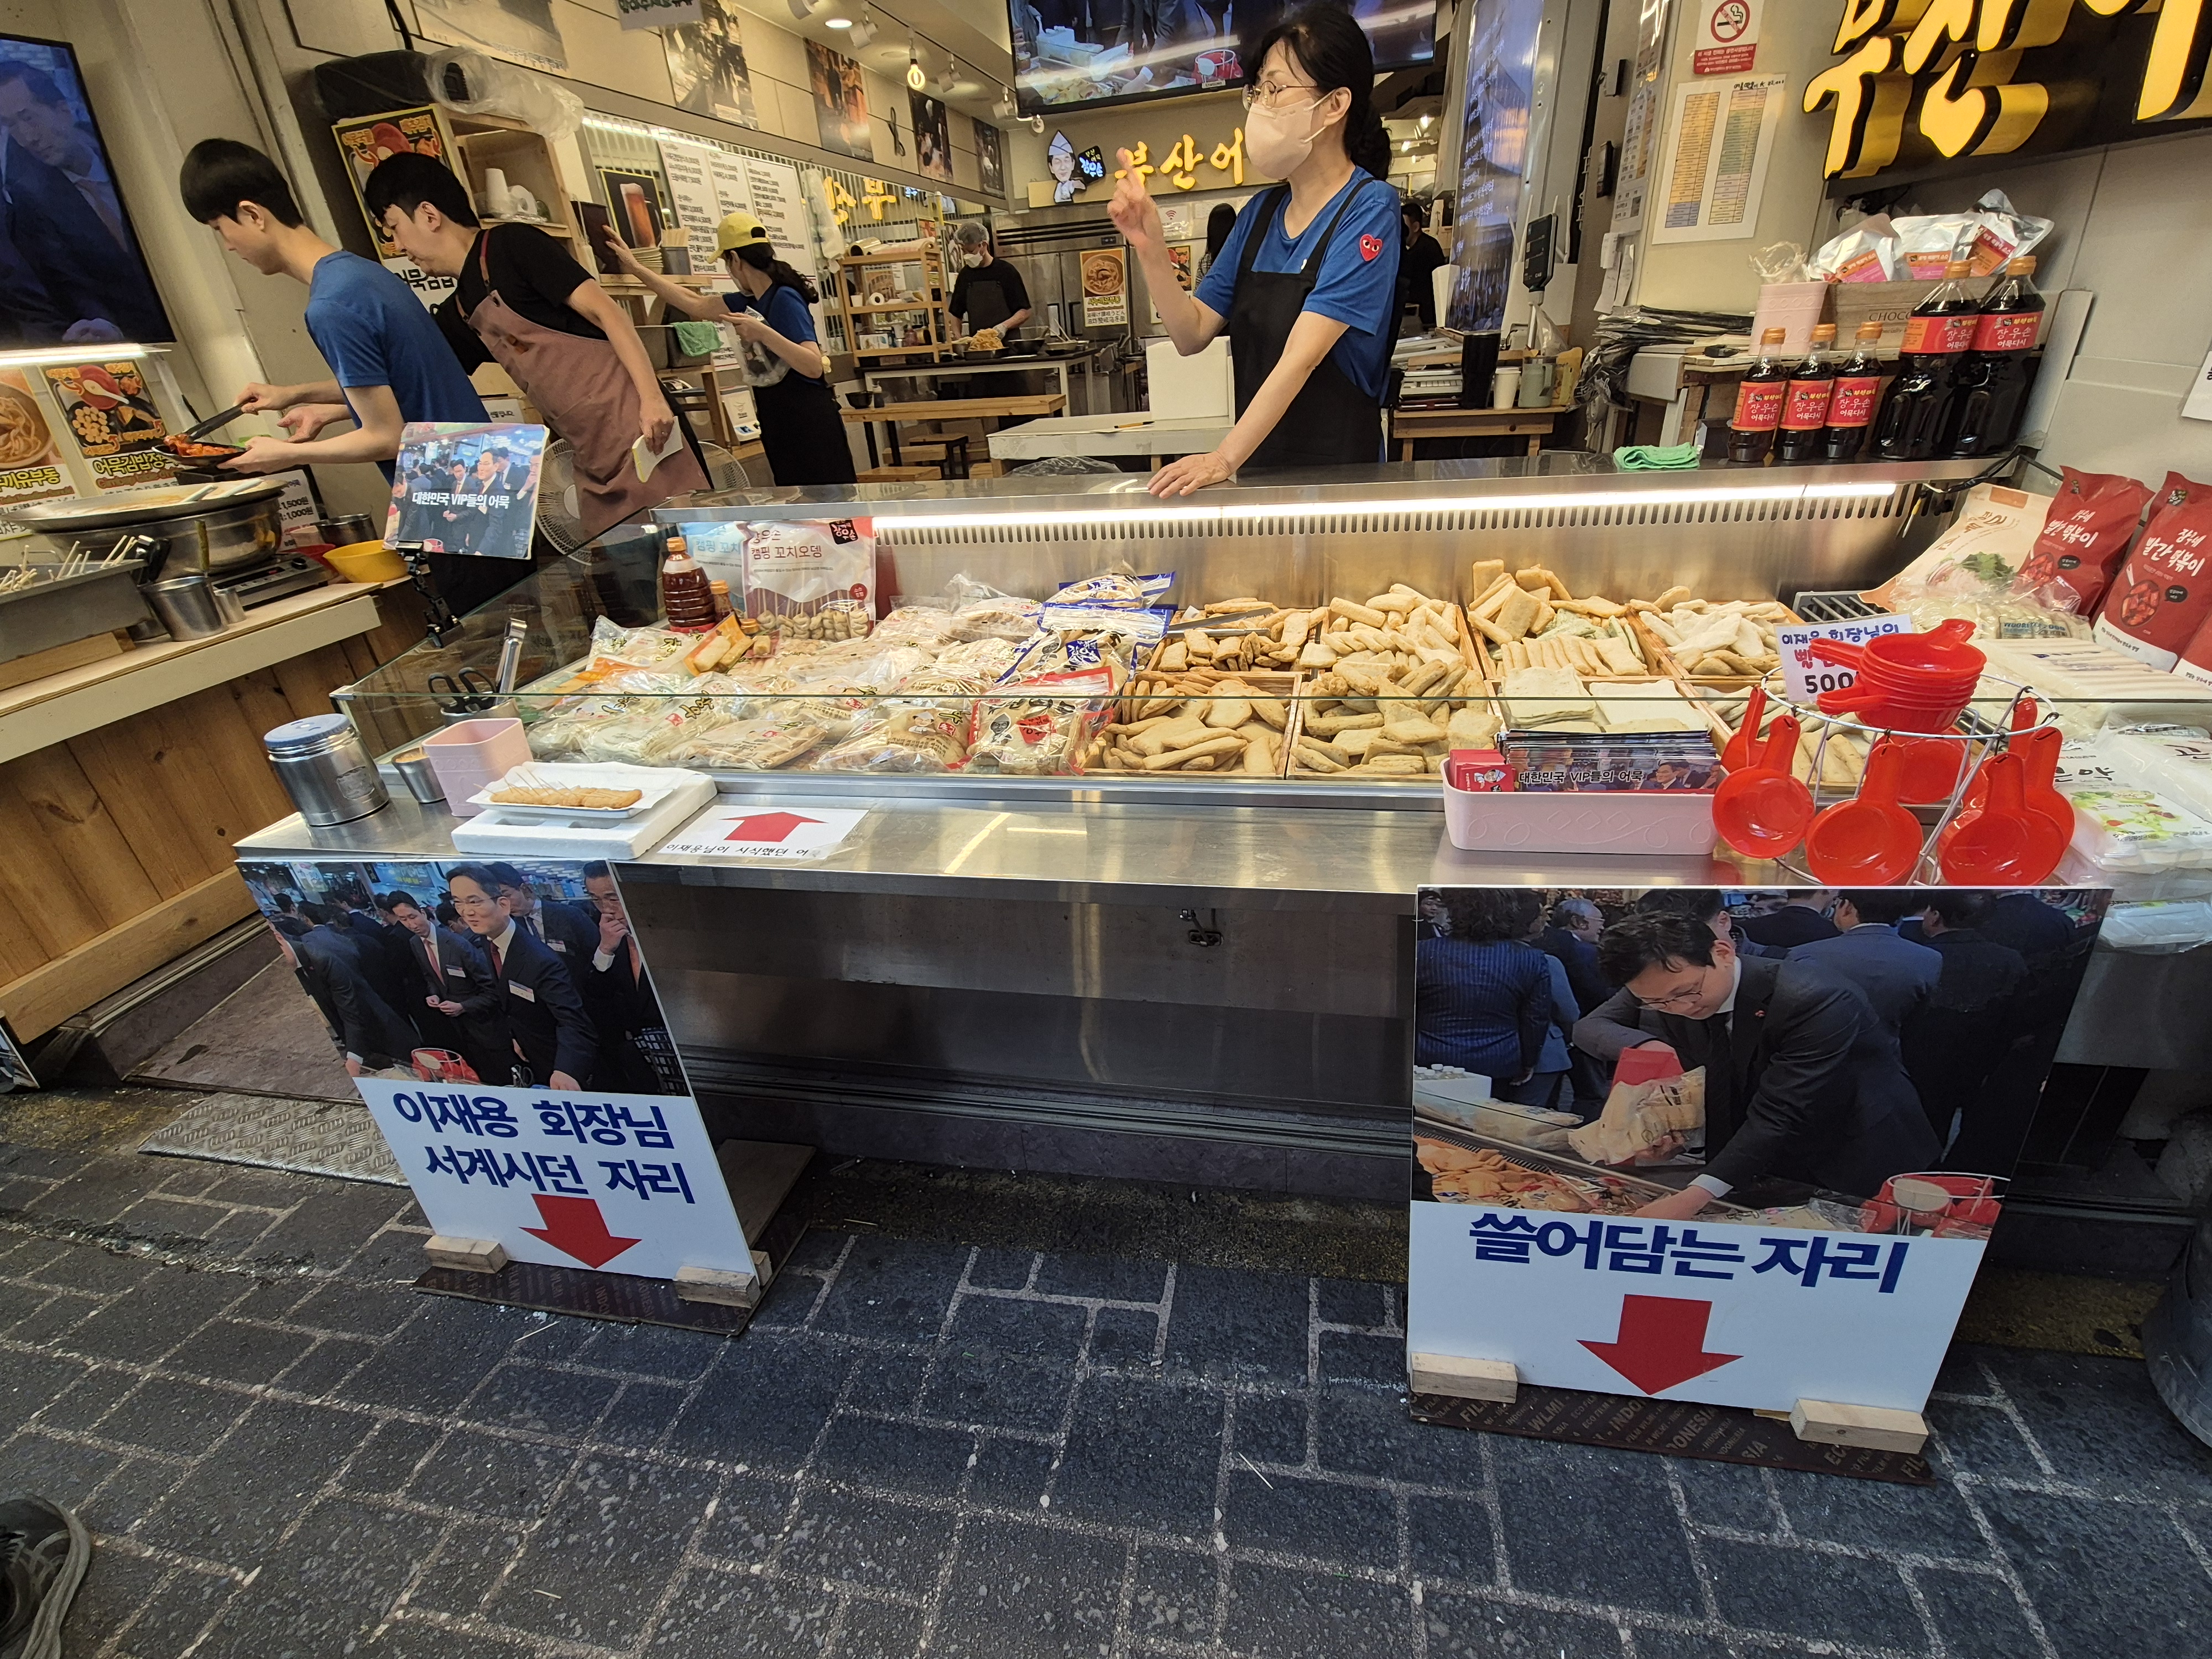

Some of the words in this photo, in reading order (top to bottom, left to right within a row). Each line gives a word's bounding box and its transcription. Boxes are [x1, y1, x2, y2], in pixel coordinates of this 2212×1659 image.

[1803, 0, 2212, 180] 부산
[1079, 156, 1103, 178] 장우손
[1995, 327, 2032, 340] 장우손
[1750, 403, 1778, 414] 장우손
[1795, 401, 1825, 413] 장우손
[1839, 398, 1871, 410] 장우손
[1839, 409, 1866, 417] 어묵다시
[411, 491, 449, 506] 대한민국
[451, 493, 487, 508] VIP들의
[488, 494, 510, 509] 어묵
[2062, 524, 2099, 548] 떡볶이
[752, 545, 770, 560] 캠핑
[774, 545, 823, 560] 꼬치오뎅
[2167, 549, 2206, 577] 떡볶이
[1519, 771, 1565, 784] 대한민국
[1569, 770, 1614, 783] VIP들의
[1618, 769, 1644, 784] 어묵
[666, 842, 729, 858] 이재용님이
[735, 845, 791, 859] 시식했던
[392, 1091, 520, 1139] 이재용
[532, 1098, 675, 1150] 회장님
[425, 1144, 590, 1196] 서계시던
[605, 1157, 696, 1206] 자리
[1469, 1212, 1746, 1280] 쓸어담는
[1750, 1235, 1910, 1295] 자리
